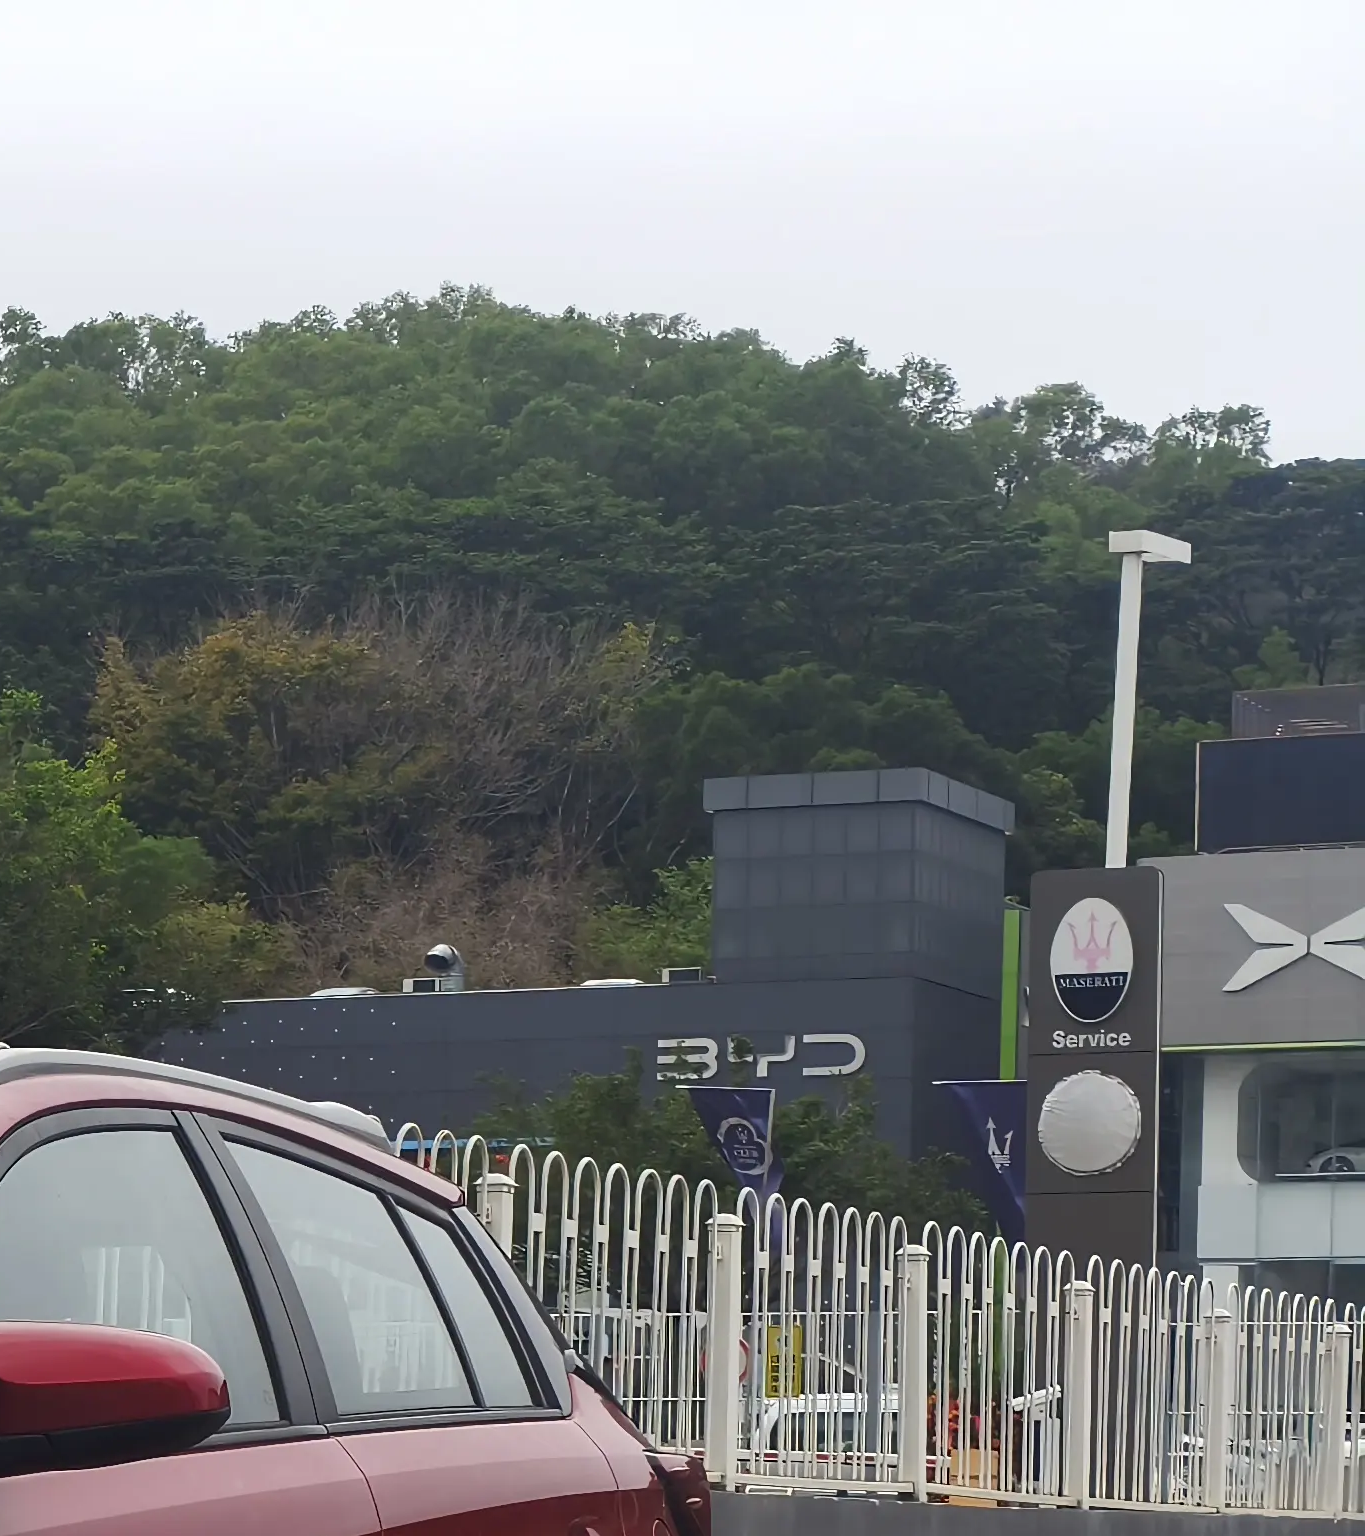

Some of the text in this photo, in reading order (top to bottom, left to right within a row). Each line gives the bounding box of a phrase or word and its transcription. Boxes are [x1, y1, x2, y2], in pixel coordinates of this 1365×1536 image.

[1059, 975, 1124, 988] MASERATI
[1052, 1029, 1132, 1049] Service
[656, 1033, 866, 1080] BYD
